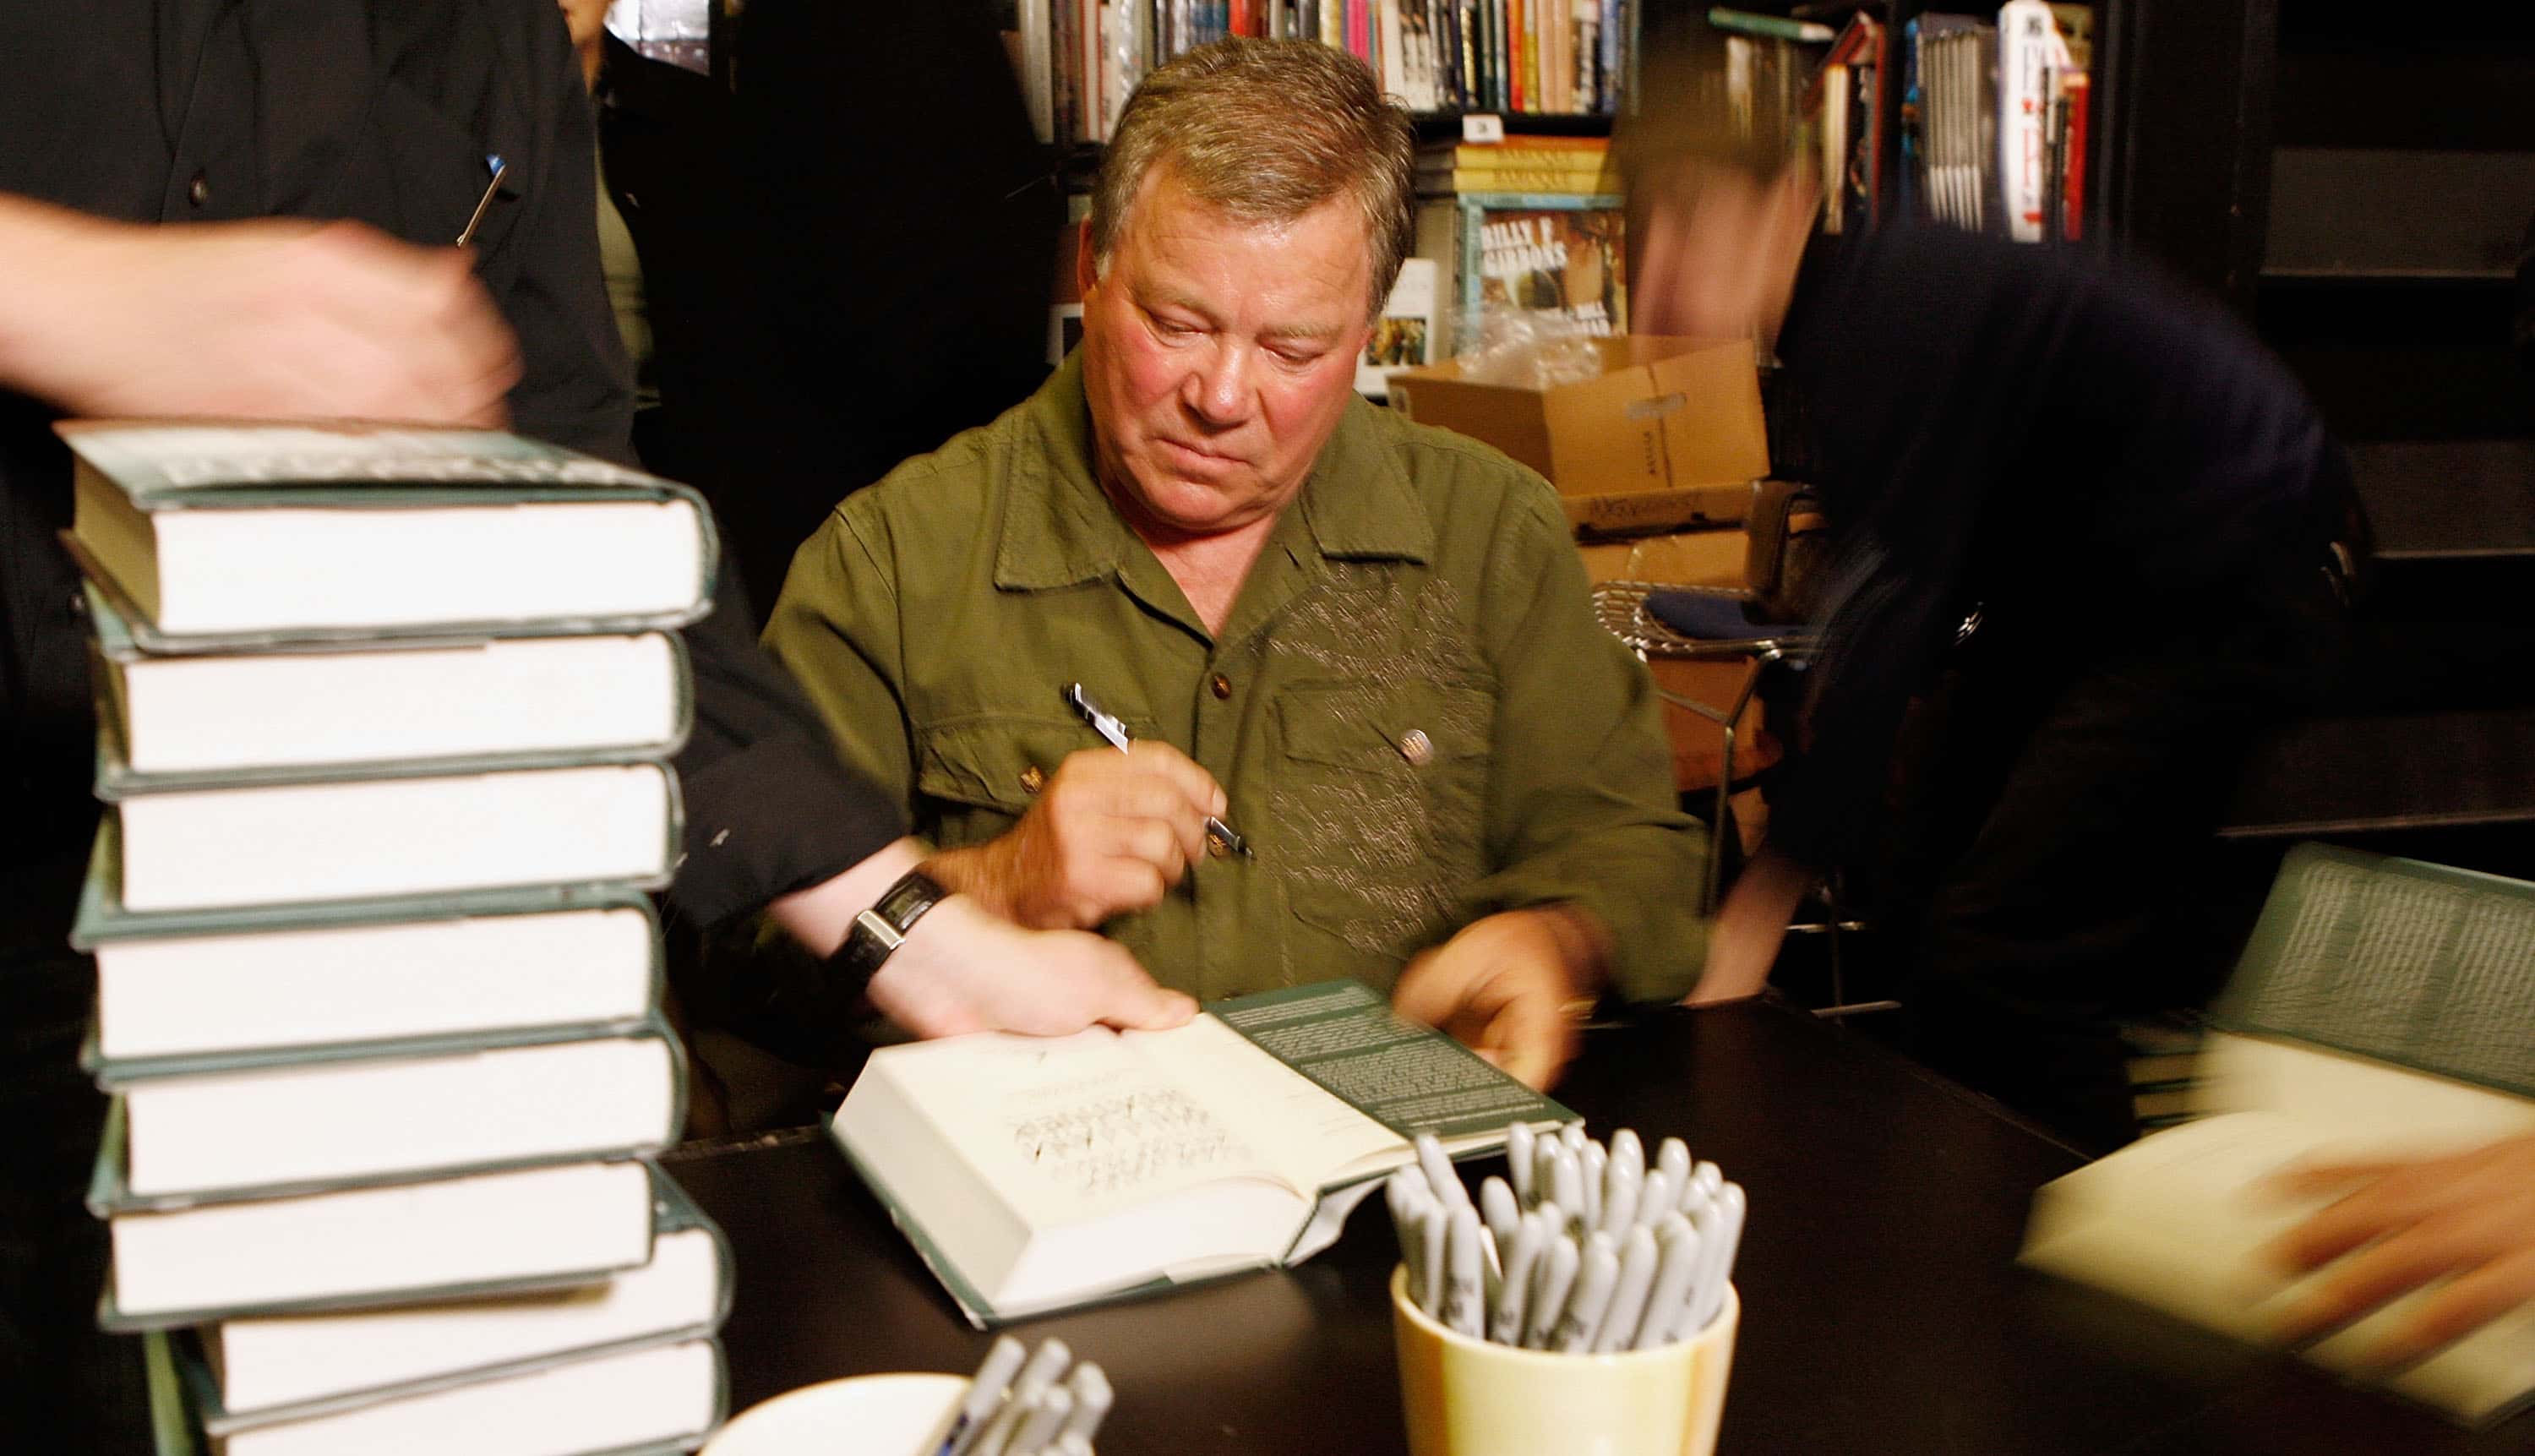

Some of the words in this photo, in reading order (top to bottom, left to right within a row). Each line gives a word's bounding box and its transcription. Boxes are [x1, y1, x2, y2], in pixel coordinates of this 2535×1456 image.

[1480, 221, 1534, 250] BILLY
[1539, 216, 1555, 245] F
[1482, 241, 1568, 277] GIBBONS
